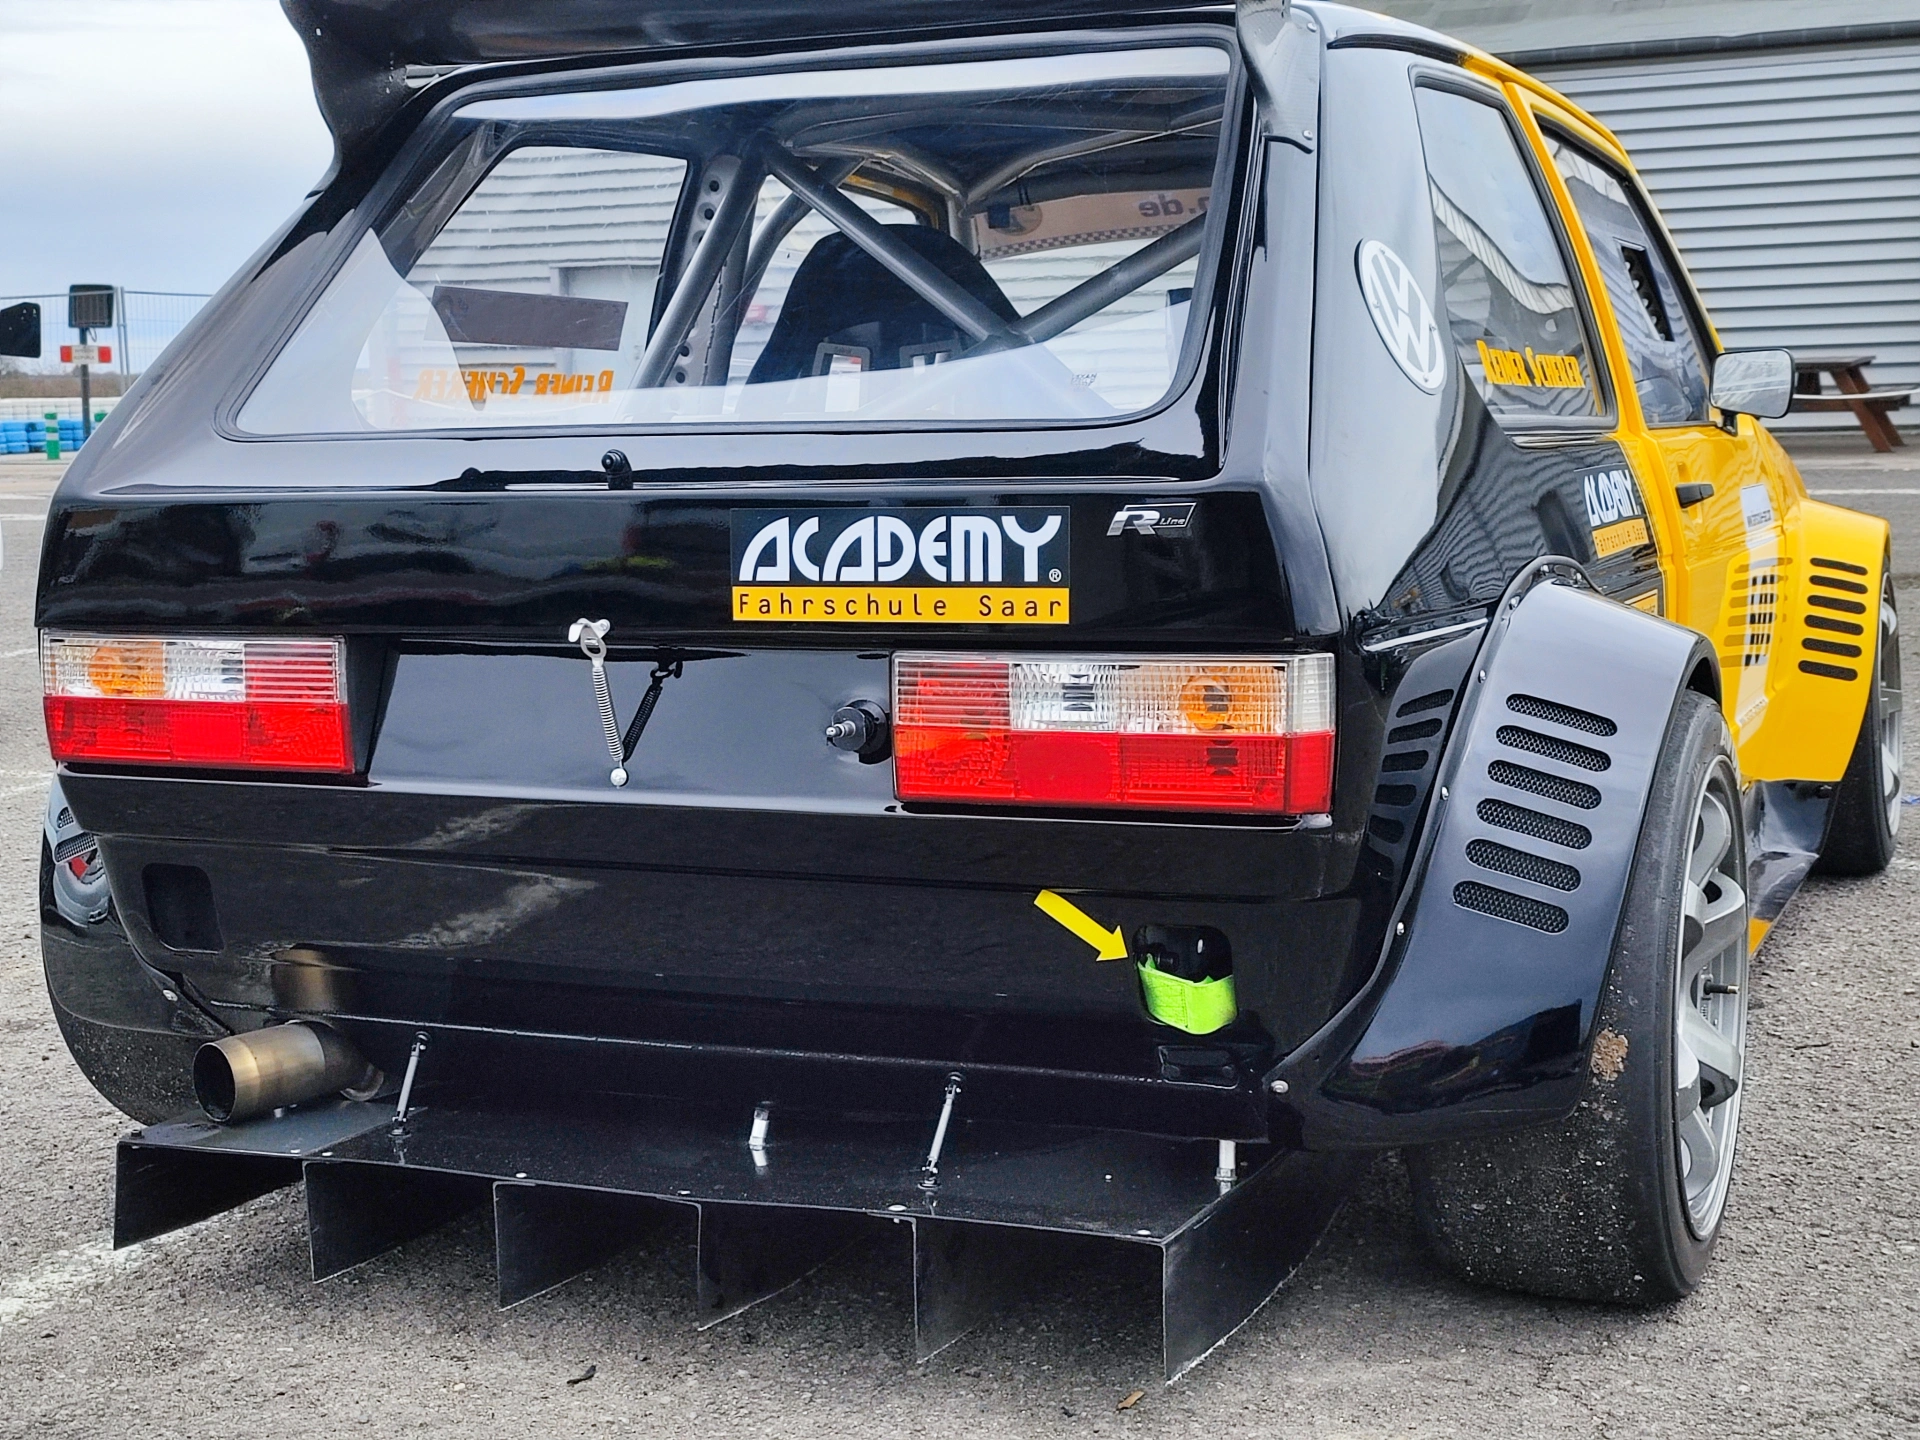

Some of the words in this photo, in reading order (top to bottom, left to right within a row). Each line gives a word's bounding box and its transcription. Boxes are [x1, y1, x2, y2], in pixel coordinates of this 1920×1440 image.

[738, 515, 1062, 582] ACADEMY
[738, 593, 948, 616] Fahrschule
[978, 594, 1062, 617] Saar
